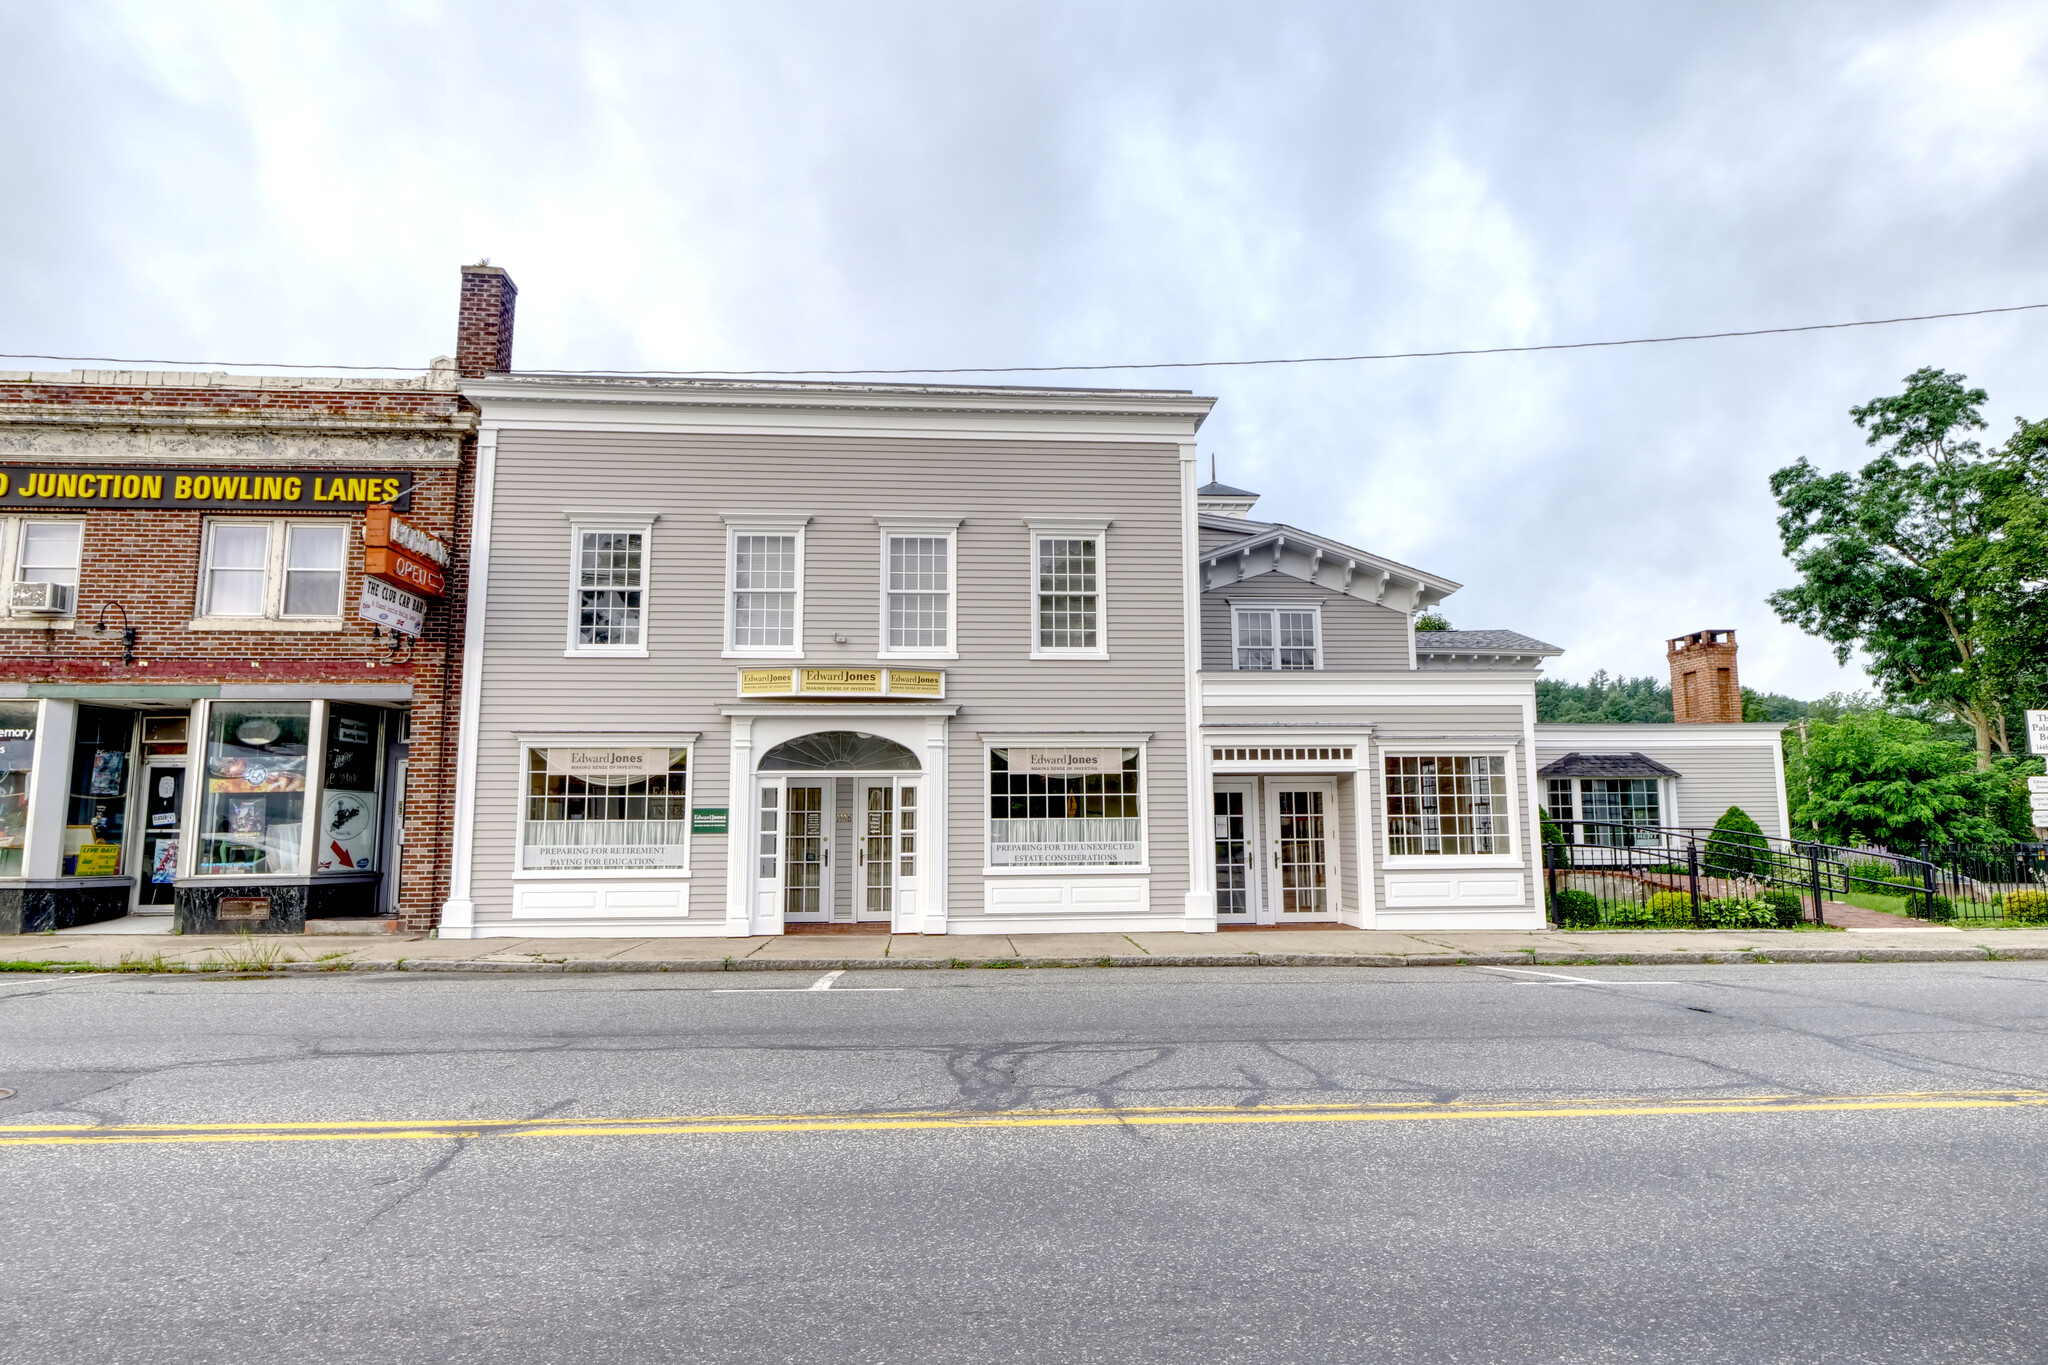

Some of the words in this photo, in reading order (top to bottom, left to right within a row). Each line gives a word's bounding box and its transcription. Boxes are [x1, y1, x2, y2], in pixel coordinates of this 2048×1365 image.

[18, 473, 163, 500] JUNCTION
[174, 475, 303, 502] BOWLING
[313, 477, 400, 503] LANES
[396, 557, 427, 586] OPEN
[367, 580, 380, 597] THE
[381, 586, 397, 604] CLUB
[398, 593, 411, 611] CAR
[412, 598, 425, 614] BAR
[744, 673, 770, 682] Edward
[770, 673, 791, 683] Jones
[806, 670, 844, 681] Edward
[844, 670, 876, 682] Jones
[891, 674, 917, 683] Edward
[917, 675, 939, 684] Jones
[571, 752, 610, 763] Edward
[610, 752, 643, 764] Jones
[1031, 754, 1067, 764] Edward
[1067, 754, 1098, 765] Jones
[540, 847, 589, 855] PREPARING
[590, 847, 608, 855] FOR
[610, 847, 666, 855] RETIREMENT
[996, 843, 1042, 852] PREPARING
[1044, 843, 1061, 851] FOR
[1061, 843, 1080, 851] THE
[1080, 843, 1135, 851] UNEXPECTED
[550, 858, 582, 866] PAYING
[584, 858, 601, 866] FOR
[603, 857, 655, 865] EDUCATION
[1014, 854, 1044, 862] ESTATE
[1045, 853, 1118, 861] CONSIDERATIONS
